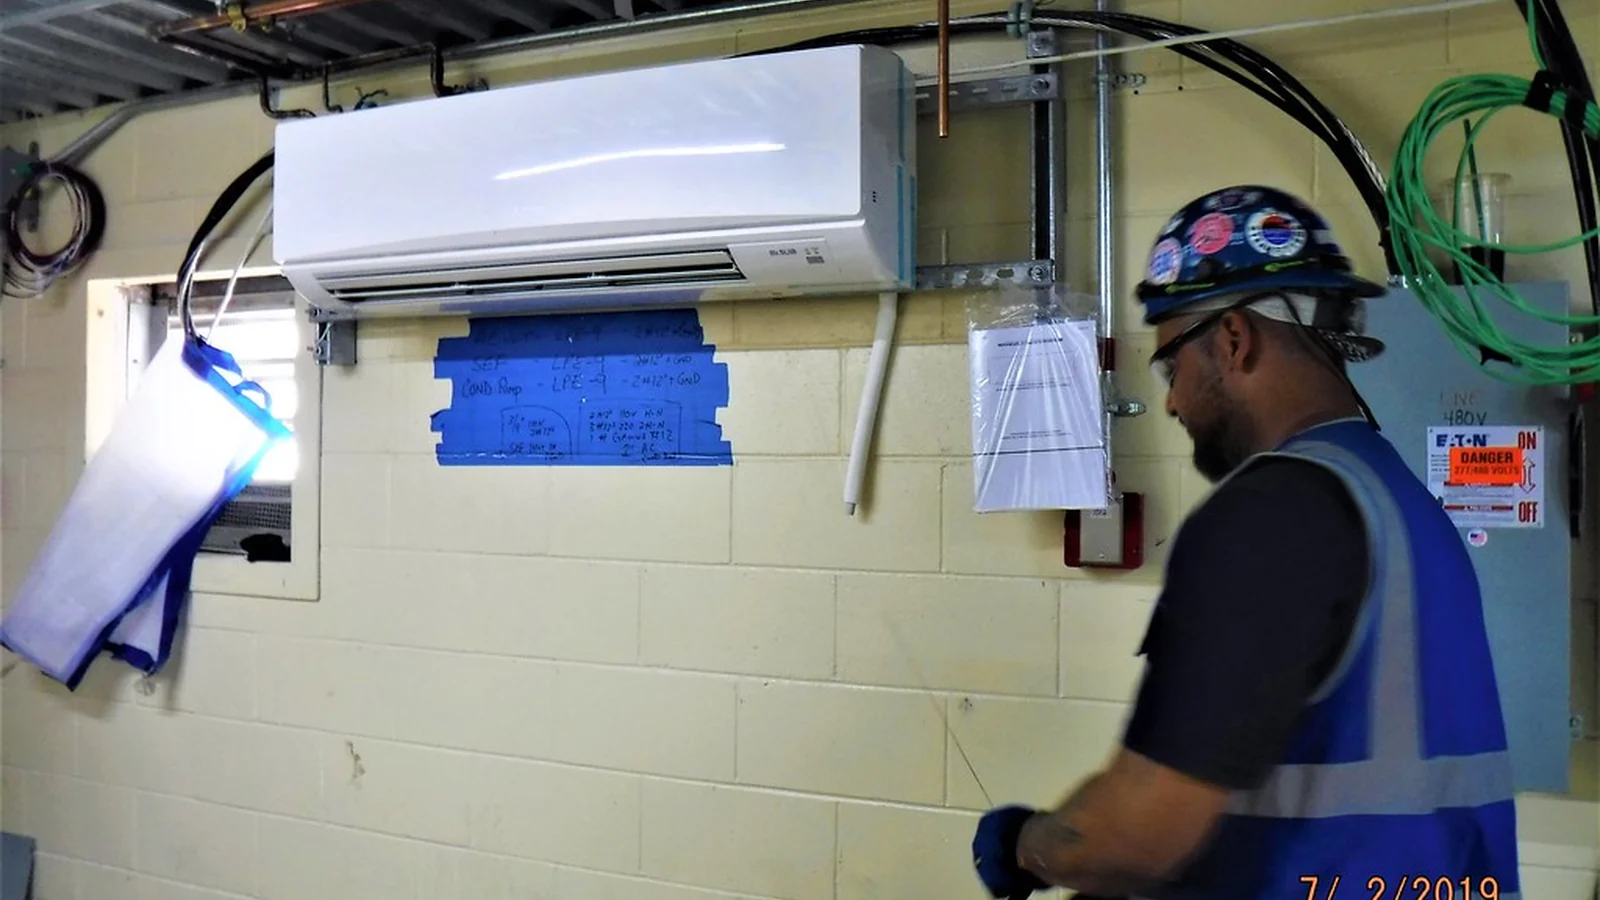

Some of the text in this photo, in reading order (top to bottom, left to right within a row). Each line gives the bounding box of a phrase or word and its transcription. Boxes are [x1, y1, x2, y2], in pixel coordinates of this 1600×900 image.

[1442, 408, 1488, 426] 480V
[1517, 431, 1537, 450] ON
[1460, 451, 1513, 463] DANGER
[1491, 465, 1519, 475] VOLTS
[1518, 501, 1538, 523] OFF
